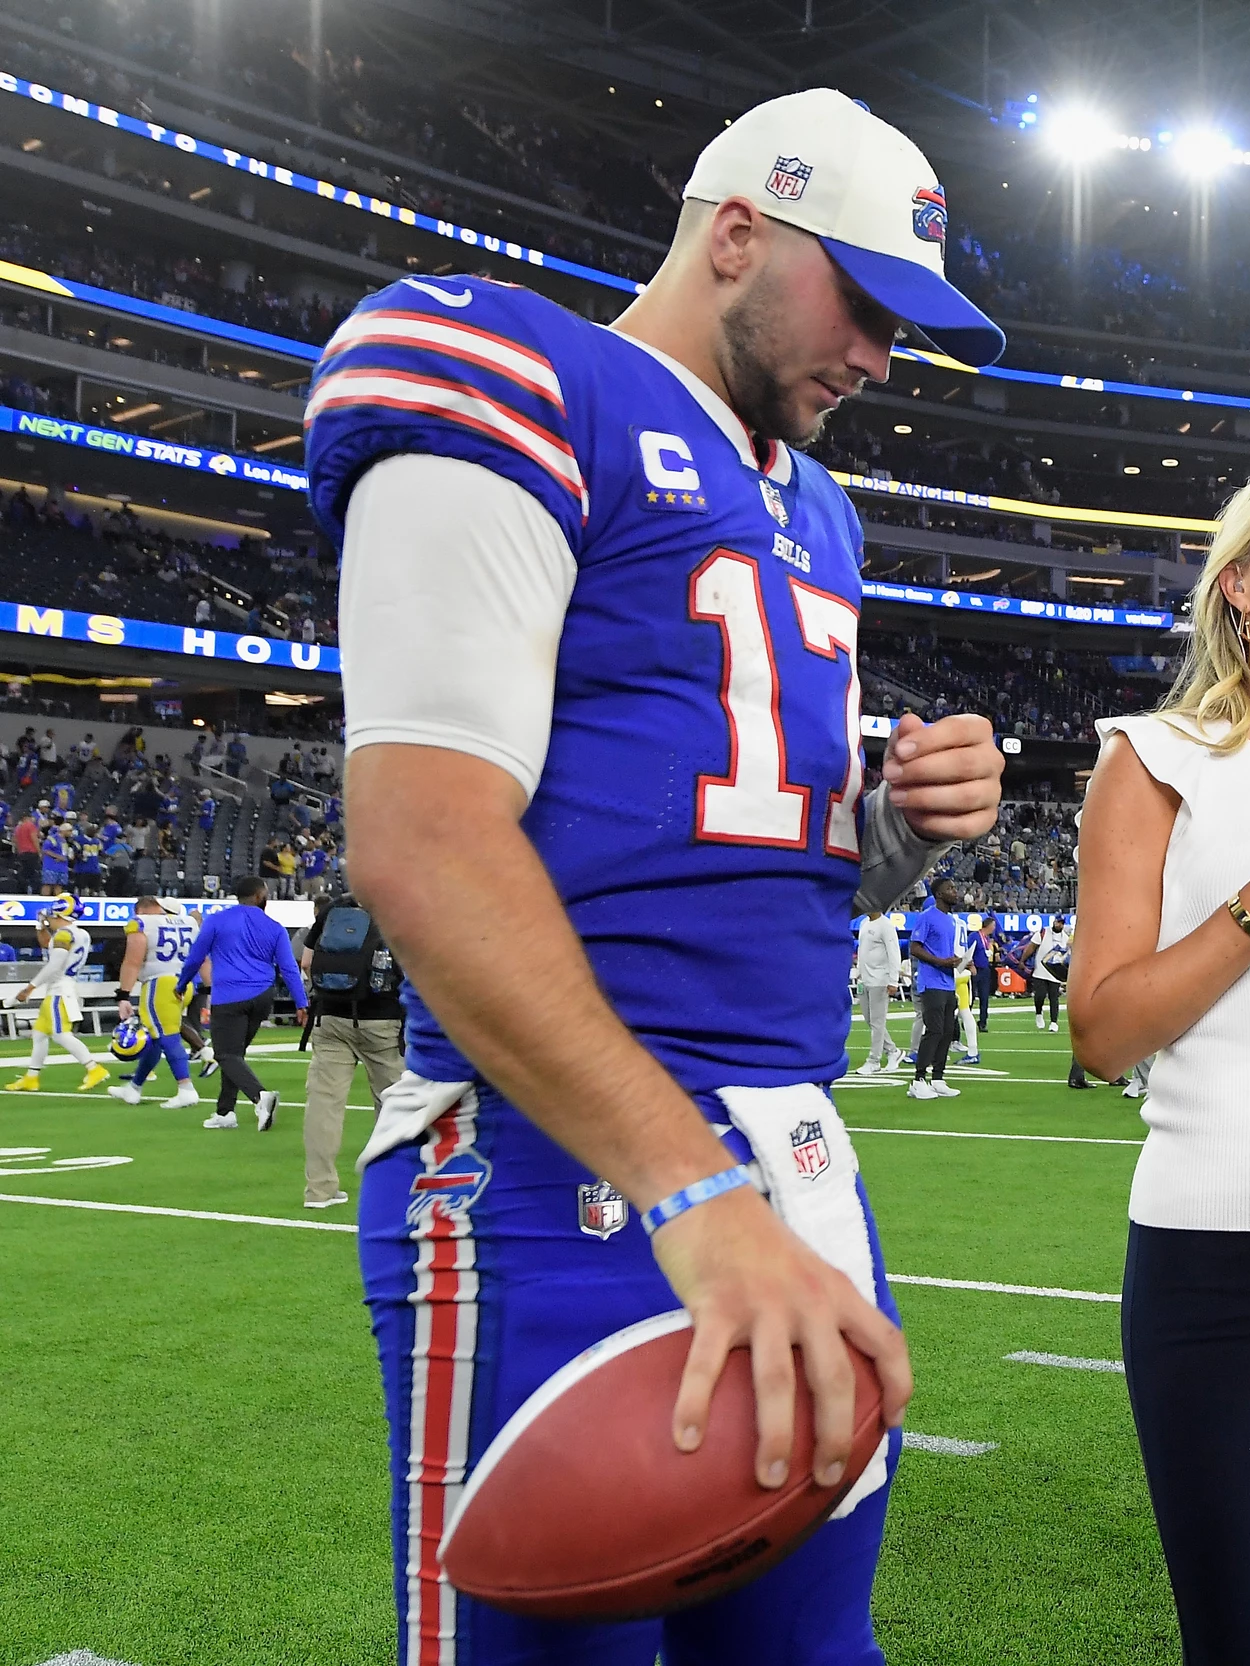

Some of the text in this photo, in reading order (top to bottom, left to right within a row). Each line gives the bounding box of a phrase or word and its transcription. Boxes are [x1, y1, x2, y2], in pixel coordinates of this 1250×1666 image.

[147, 122, 197, 152] TO
[222, 148, 294, 185] THE
[317, 180, 416, 225] RAMS
[438, 220, 544, 266] HOUSE
[770, 171, 799, 197] NFL
[19, 414, 202, 467] NEXT GEN STATS
[243, 462, 271, 482] Los
[639, 430, 700, 491] C
[849, 473, 989, 508] LOS ANGELES
[771, 532, 811, 573] BILLS
[1020, 600, 1045, 616] SEP
[1093, 608, 1115, 623] PM
[183, 627, 343, 671] HOU
[689, 546, 862, 862] 17
[1004, 741, 1020, 751] CC
[105, 904, 130, 920] Q4
[891, 914, 983, 931] RS
[156, 926, 193, 962] 55
[1000, 972, 1011, 986] G
[792, 1143, 827, 1174] NFL
[587, 1204, 620, 1229] NFL
